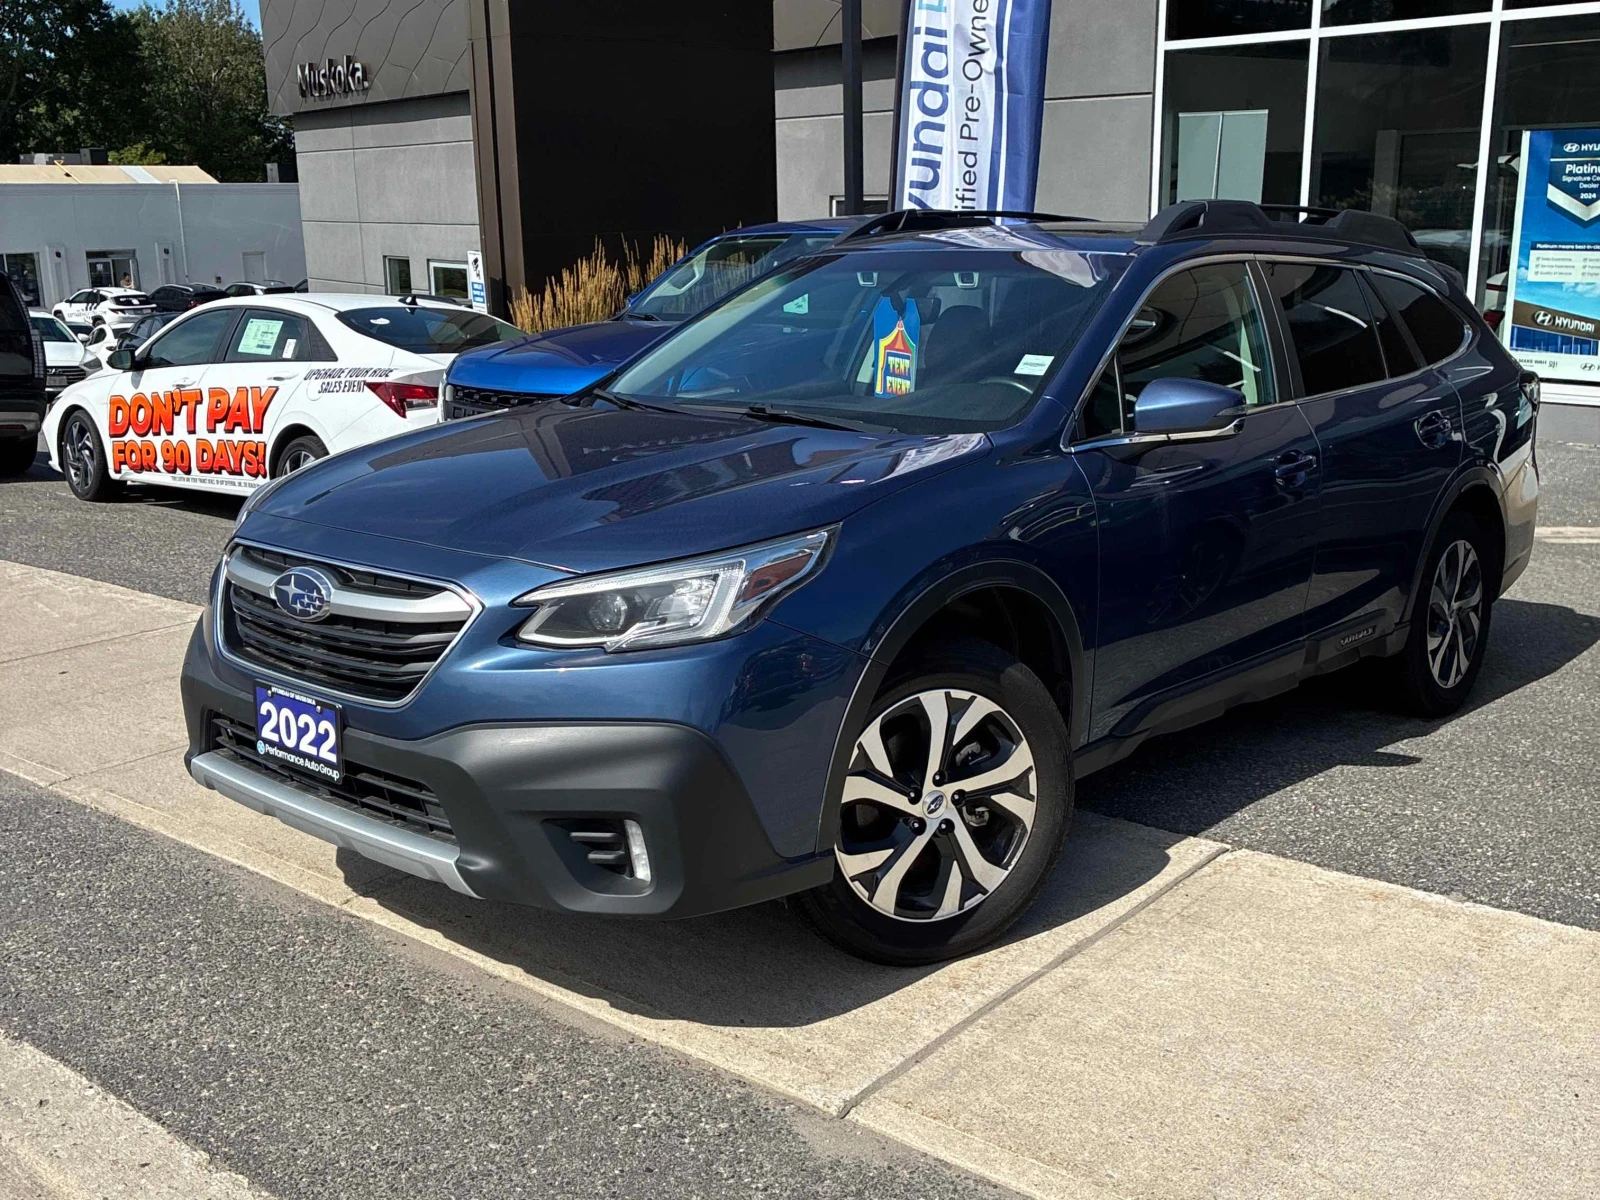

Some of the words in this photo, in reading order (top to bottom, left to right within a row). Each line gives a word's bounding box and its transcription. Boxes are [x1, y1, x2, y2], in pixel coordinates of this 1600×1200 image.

[960, 0, 989, 140] Pre-Owne
[908, 27, 949, 209] undai
[955, 151, 978, 209] ified
[1565, 163, 1600, 174] Platin
[1555, 315, 1595, 333] HYUNDAI
[304, 368, 348, 380] UPGRADE
[345, 368, 374, 378] YOUR
[888, 356, 910, 376] TENT
[318, 381, 343, 393] SALES
[342, 380, 366, 393] EVENT
[886, 376, 911, 396] EVENT
[109, 388, 203, 437] DON'T
[207, 386, 279, 434] PAY
[112, 440, 161, 474] FOR
[160, 439, 191, 475] 90
[196, 439, 267, 479] DAYS!
[260, 701, 337, 764] 2022
[265, 744, 304, 766] Performance
[304, 758, 320, 772] Auto
[319, 763, 340, 781] Group
